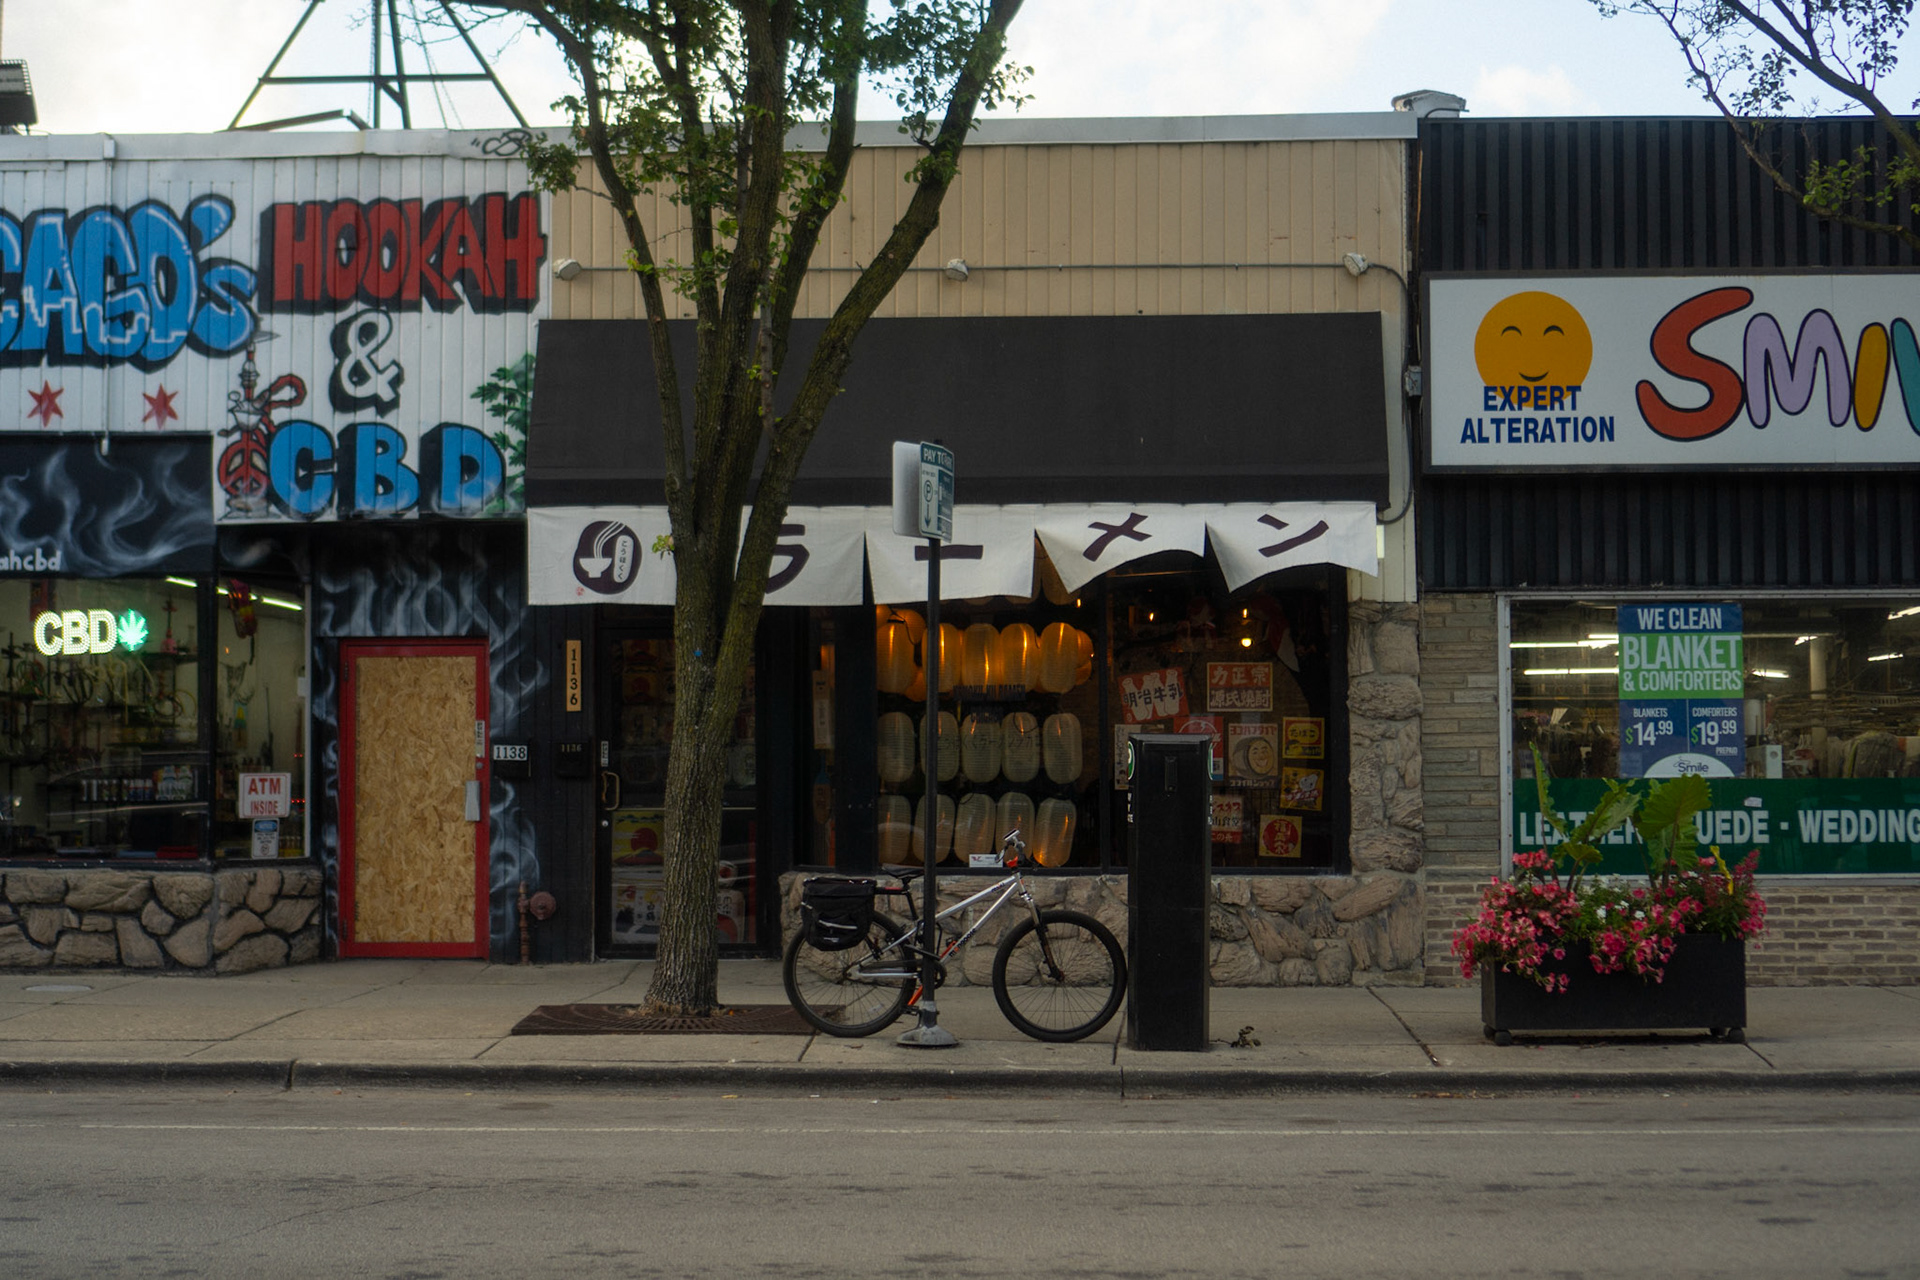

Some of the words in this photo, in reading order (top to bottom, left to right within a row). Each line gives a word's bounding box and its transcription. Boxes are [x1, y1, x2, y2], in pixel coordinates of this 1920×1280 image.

[260, 191, 547, 314] HOOKAH
[330, 308, 404, 417] &
[1483, 385, 1582, 411] EXPERT
[1460, 416, 1615, 444] ALTERATION
[923, 448, 936, 464] PAY
[270, 420, 506, 521] CBD
[1637, 608, 1665, 631] WE
[1669, 607, 1722, 630] CLEAN
[34, 609, 118, 656] CBD
[1623, 635, 1741, 670] BLANKET
[569, 649, 578, 706] 1136
[1623, 671, 1636, 692] &
[1639, 670, 1742, 691] COMFORTERS
[1633, 708, 1668, 718] BLANKETS
[1692, 707, 1737, 718] COMFORTERS
[1625, 720, 1673, 745] $14.99
[1691, 720, 1737, 746] $19.99
[496, 746, 527, 759] 1138
[1715, 747, 1738, 756] PREPAID
[1678, 762, 1709, 773] Smile
[248, 778, 281, 795] ATM
[251, 801, 278, 815] INSIDE
[1695, 810, 1770, 844] UEDE
[1797, 809, 1920, 844] WEDDING
